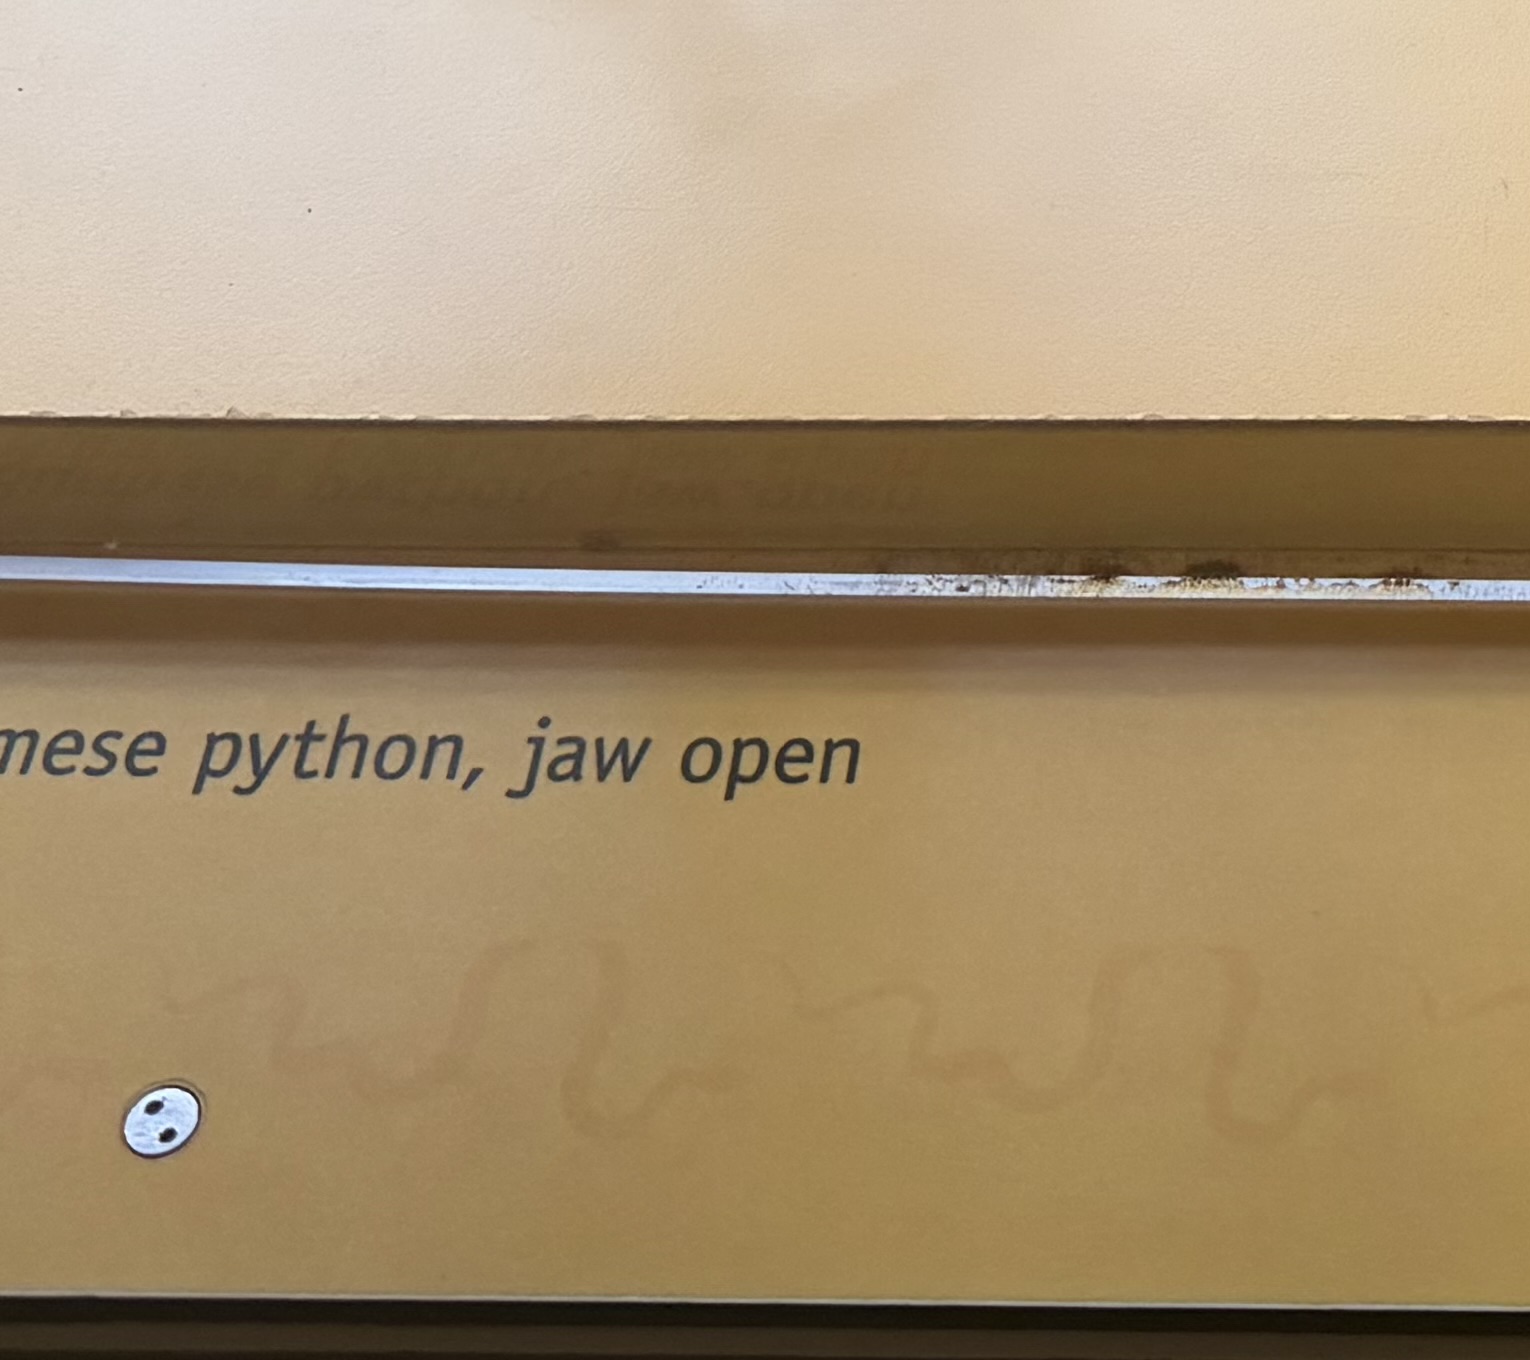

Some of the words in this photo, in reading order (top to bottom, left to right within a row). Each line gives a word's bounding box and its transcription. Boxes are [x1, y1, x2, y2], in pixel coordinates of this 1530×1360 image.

[191, 713, 486, 797] python,
[504, 715, 654, 800] jaw
[680, 736, 862, 802] open
